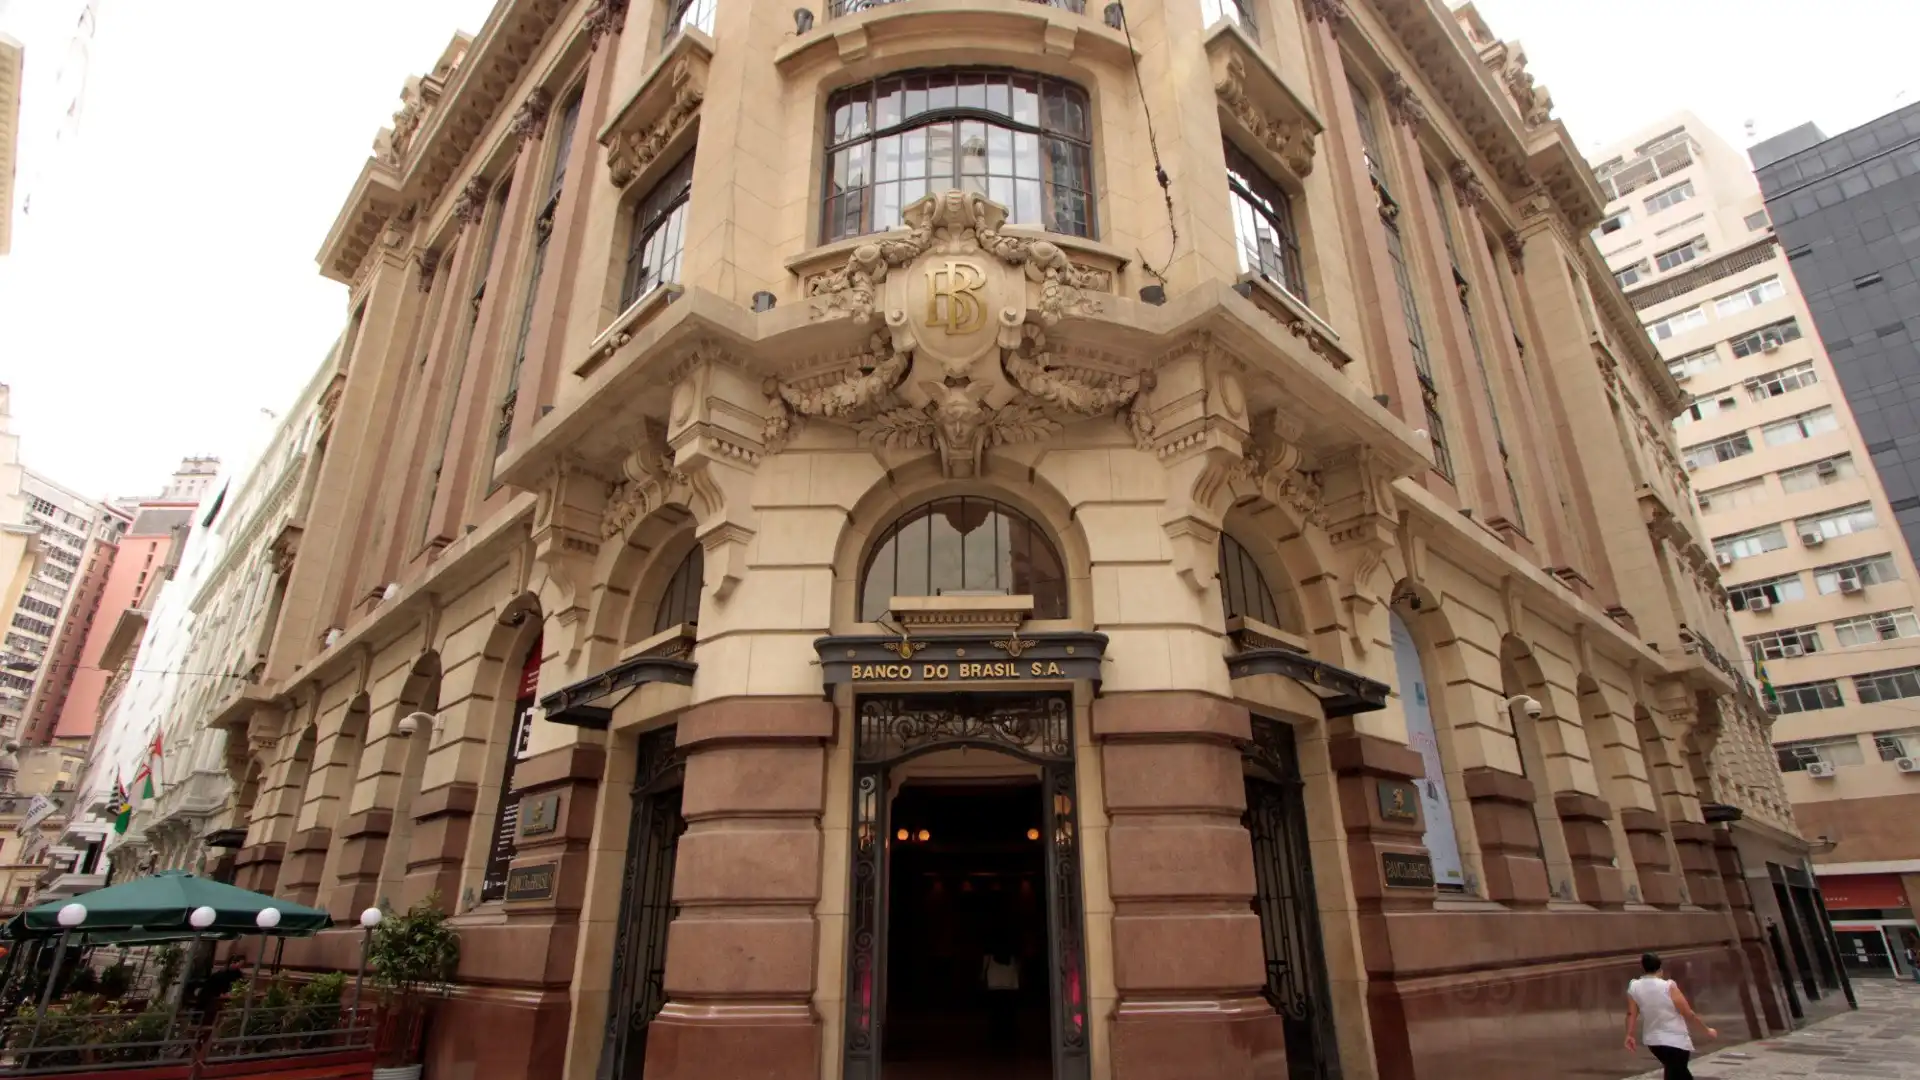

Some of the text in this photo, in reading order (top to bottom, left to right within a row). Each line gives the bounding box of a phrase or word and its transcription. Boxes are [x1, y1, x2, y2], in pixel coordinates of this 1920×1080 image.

[851, 661, 1065, 679] BANCO DO BRASIL S.A.
